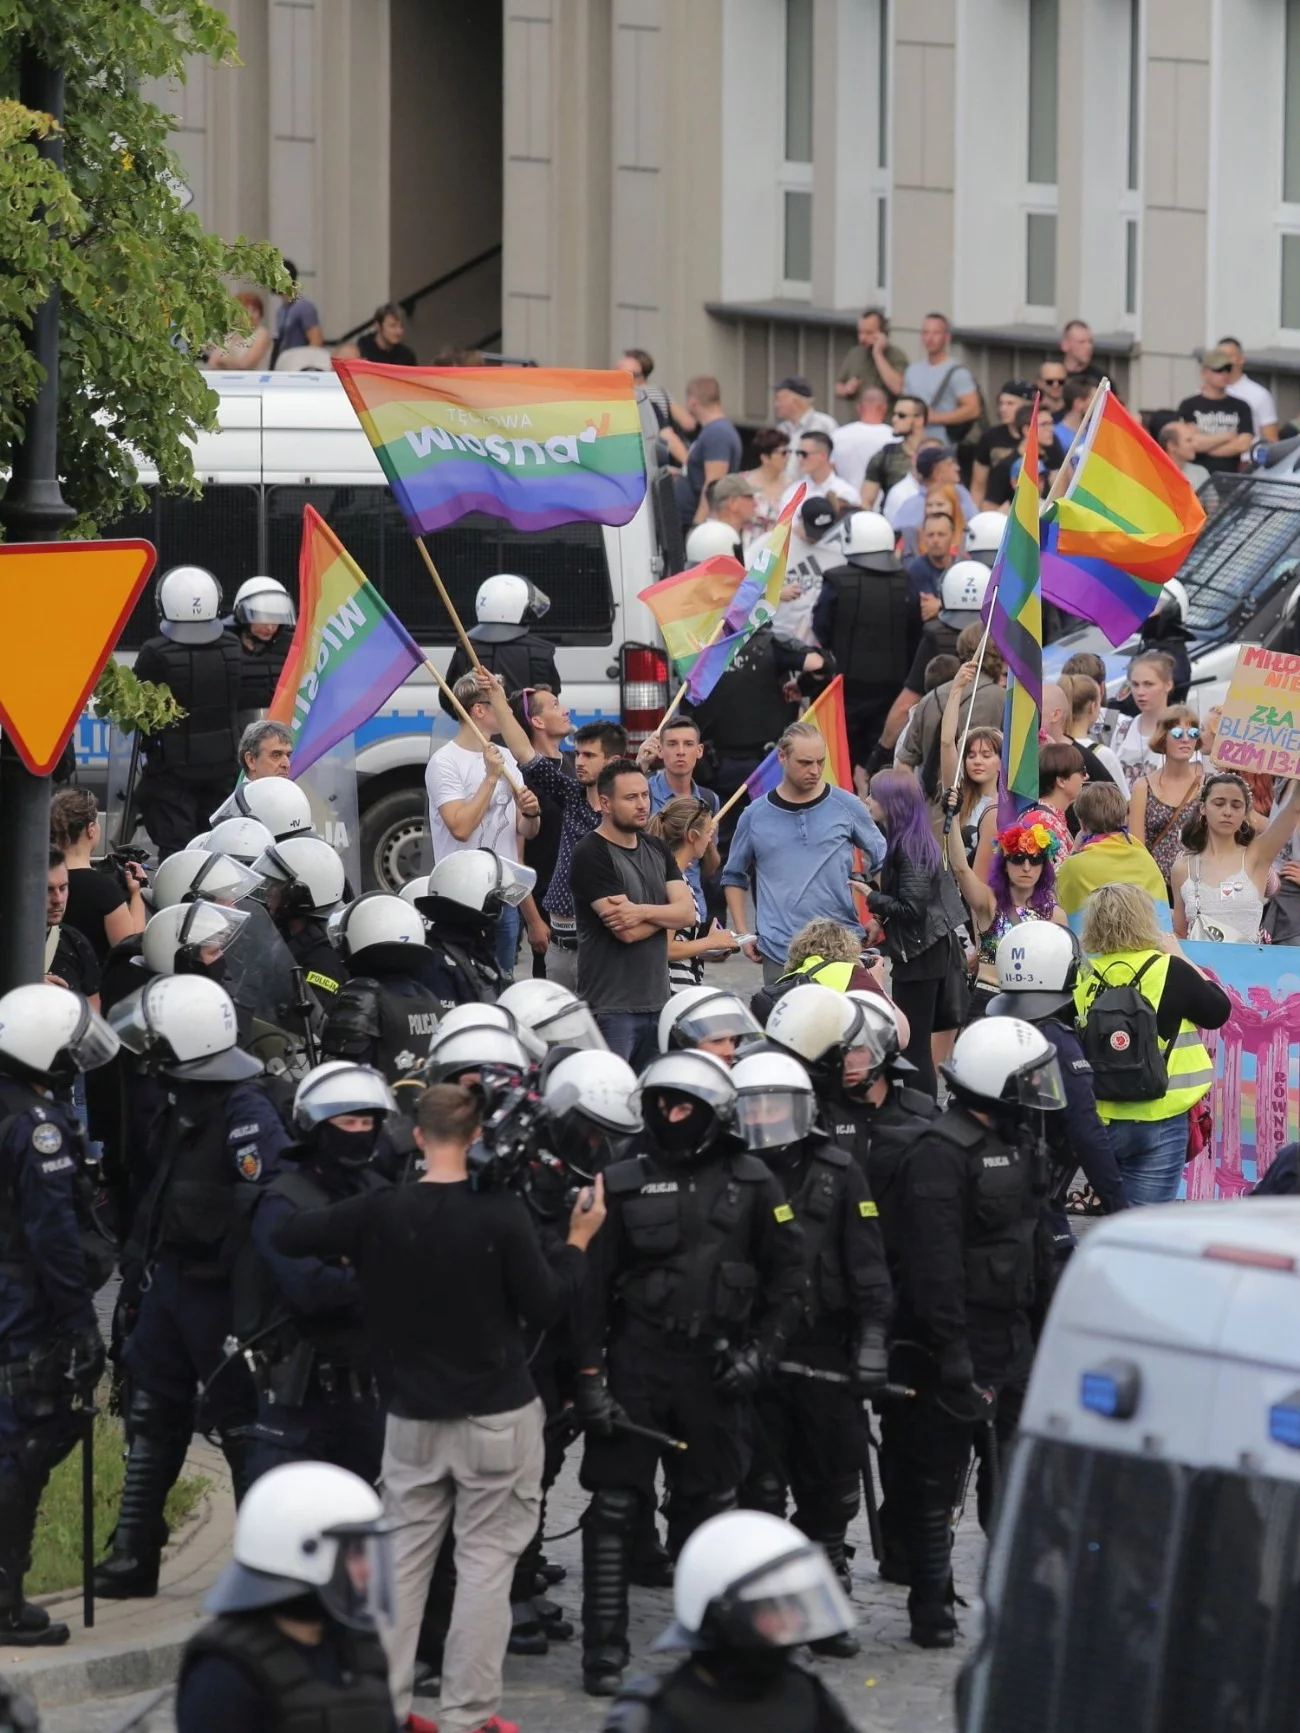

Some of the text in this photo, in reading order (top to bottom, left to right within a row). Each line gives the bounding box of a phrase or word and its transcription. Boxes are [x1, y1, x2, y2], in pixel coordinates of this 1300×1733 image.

[192, 597, 202, 607] Z
[1249, 704, 1294, 728] ZŁA
[1011, 947, 1025, 960] M
[1005, 973, 1034, 982] II-D-3
[775, 1002, 788, 1016] Z
[229, 1123, 259, 1139] POLICJA
[42, 1157, 73, 1174] POLICJA
[983, 1156, 1010, 1168] POLICJA
